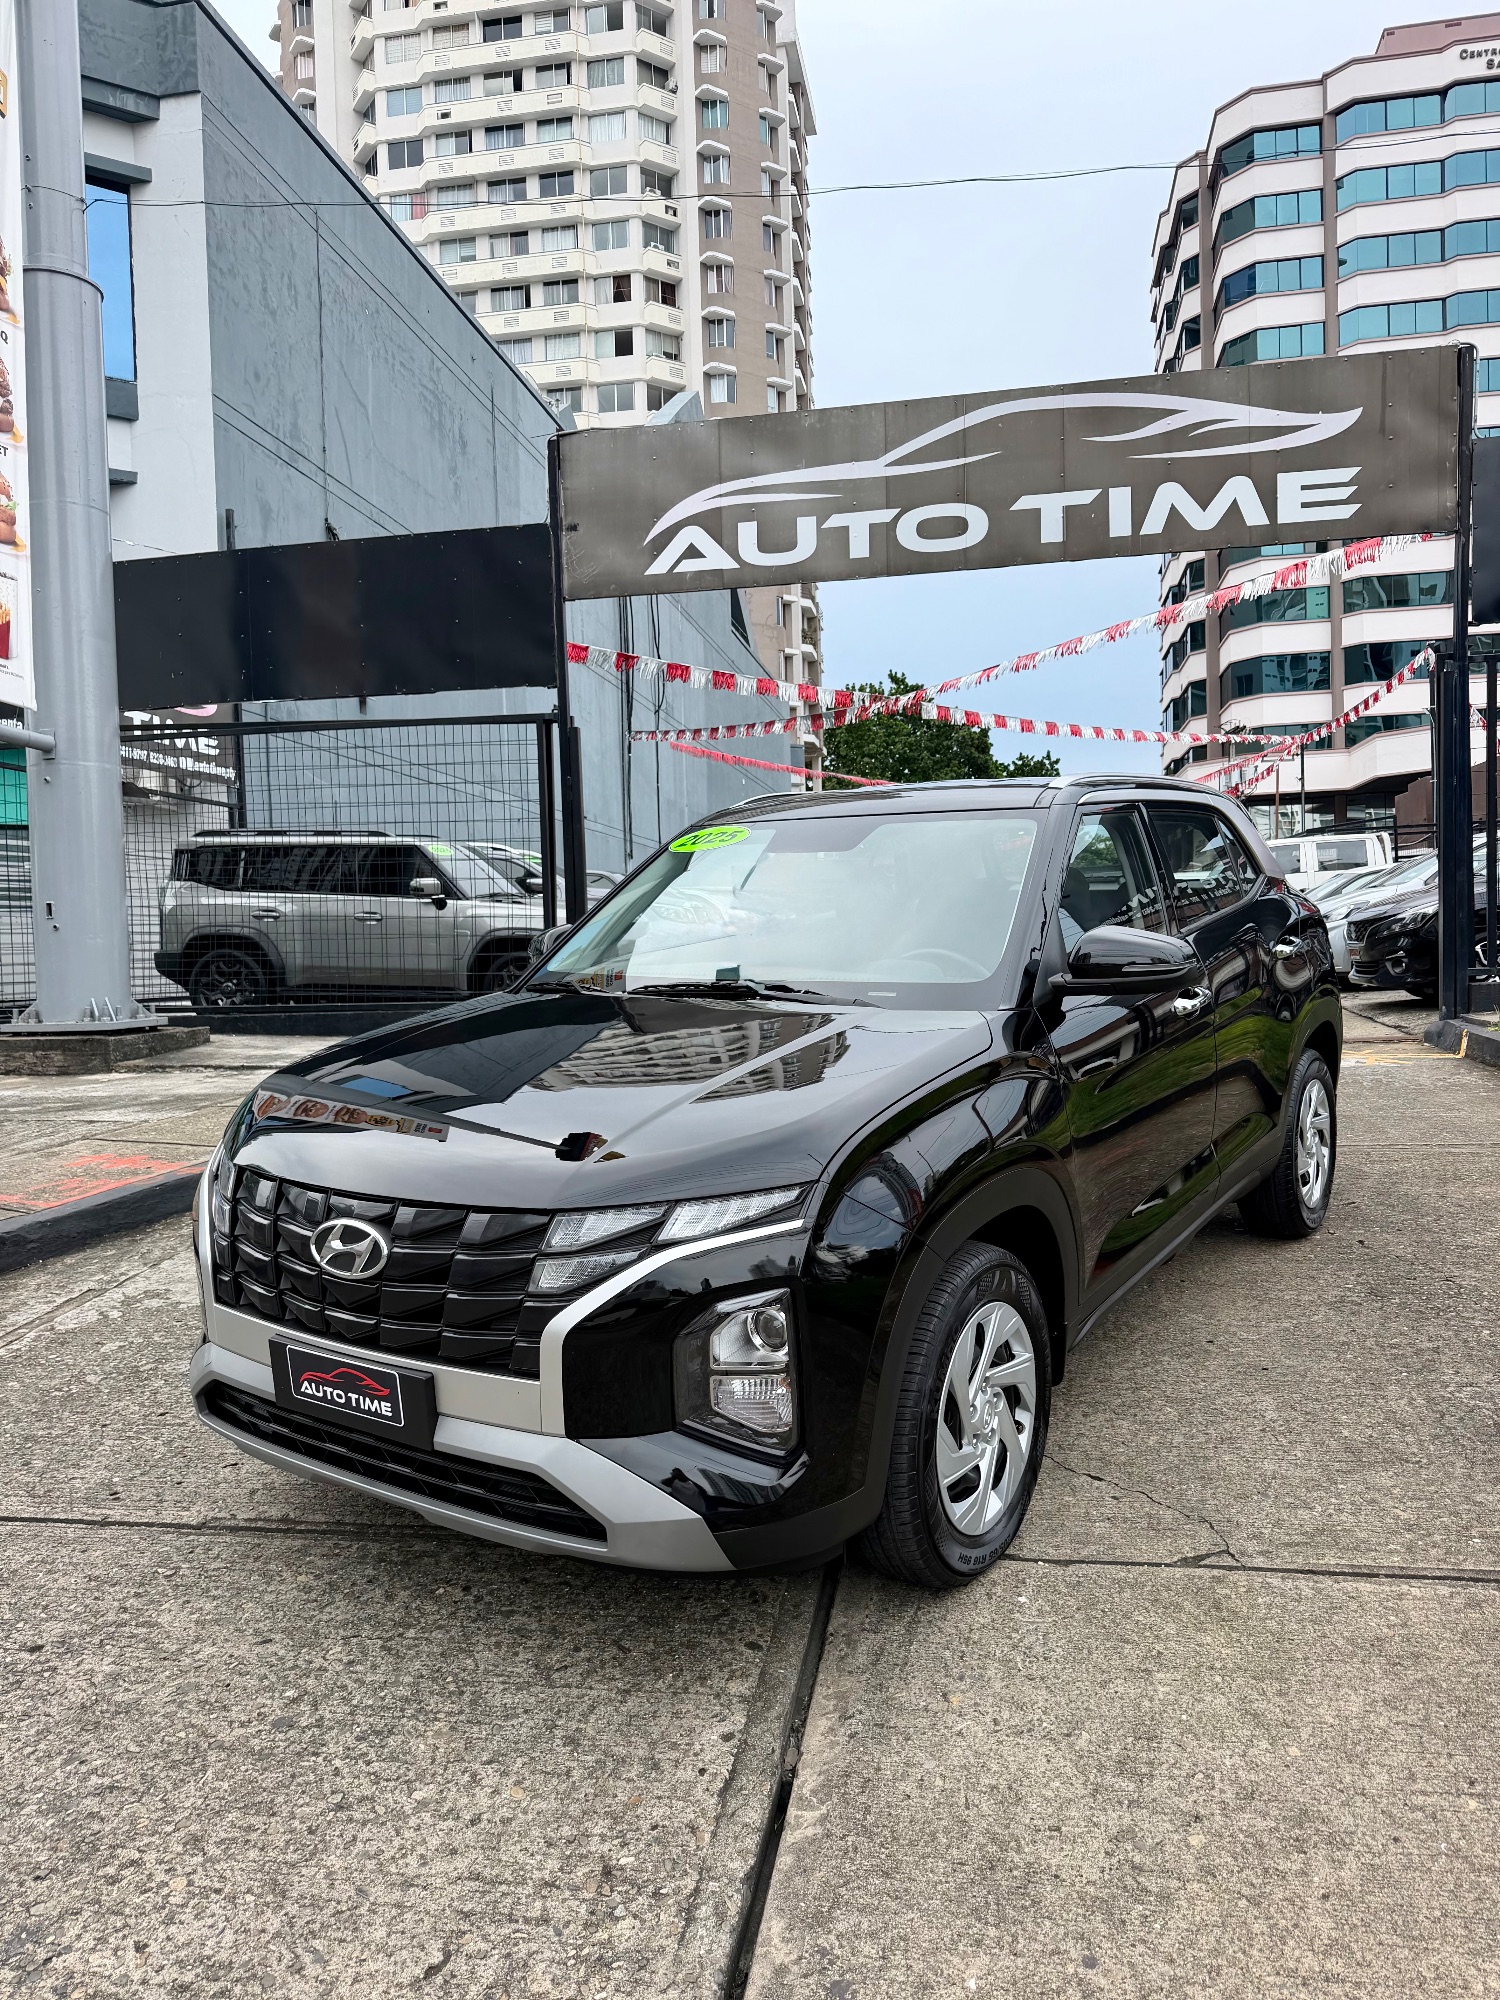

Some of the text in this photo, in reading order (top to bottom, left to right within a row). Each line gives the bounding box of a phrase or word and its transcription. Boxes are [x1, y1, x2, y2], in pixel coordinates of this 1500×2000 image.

[1460, 48, 1500, 60] CENTR
[645, 466, 1361, 576] AUTO TIME
[674, 830, 745, 848] 2025
[300, 1380, 393, 1417] AUTO TIME
